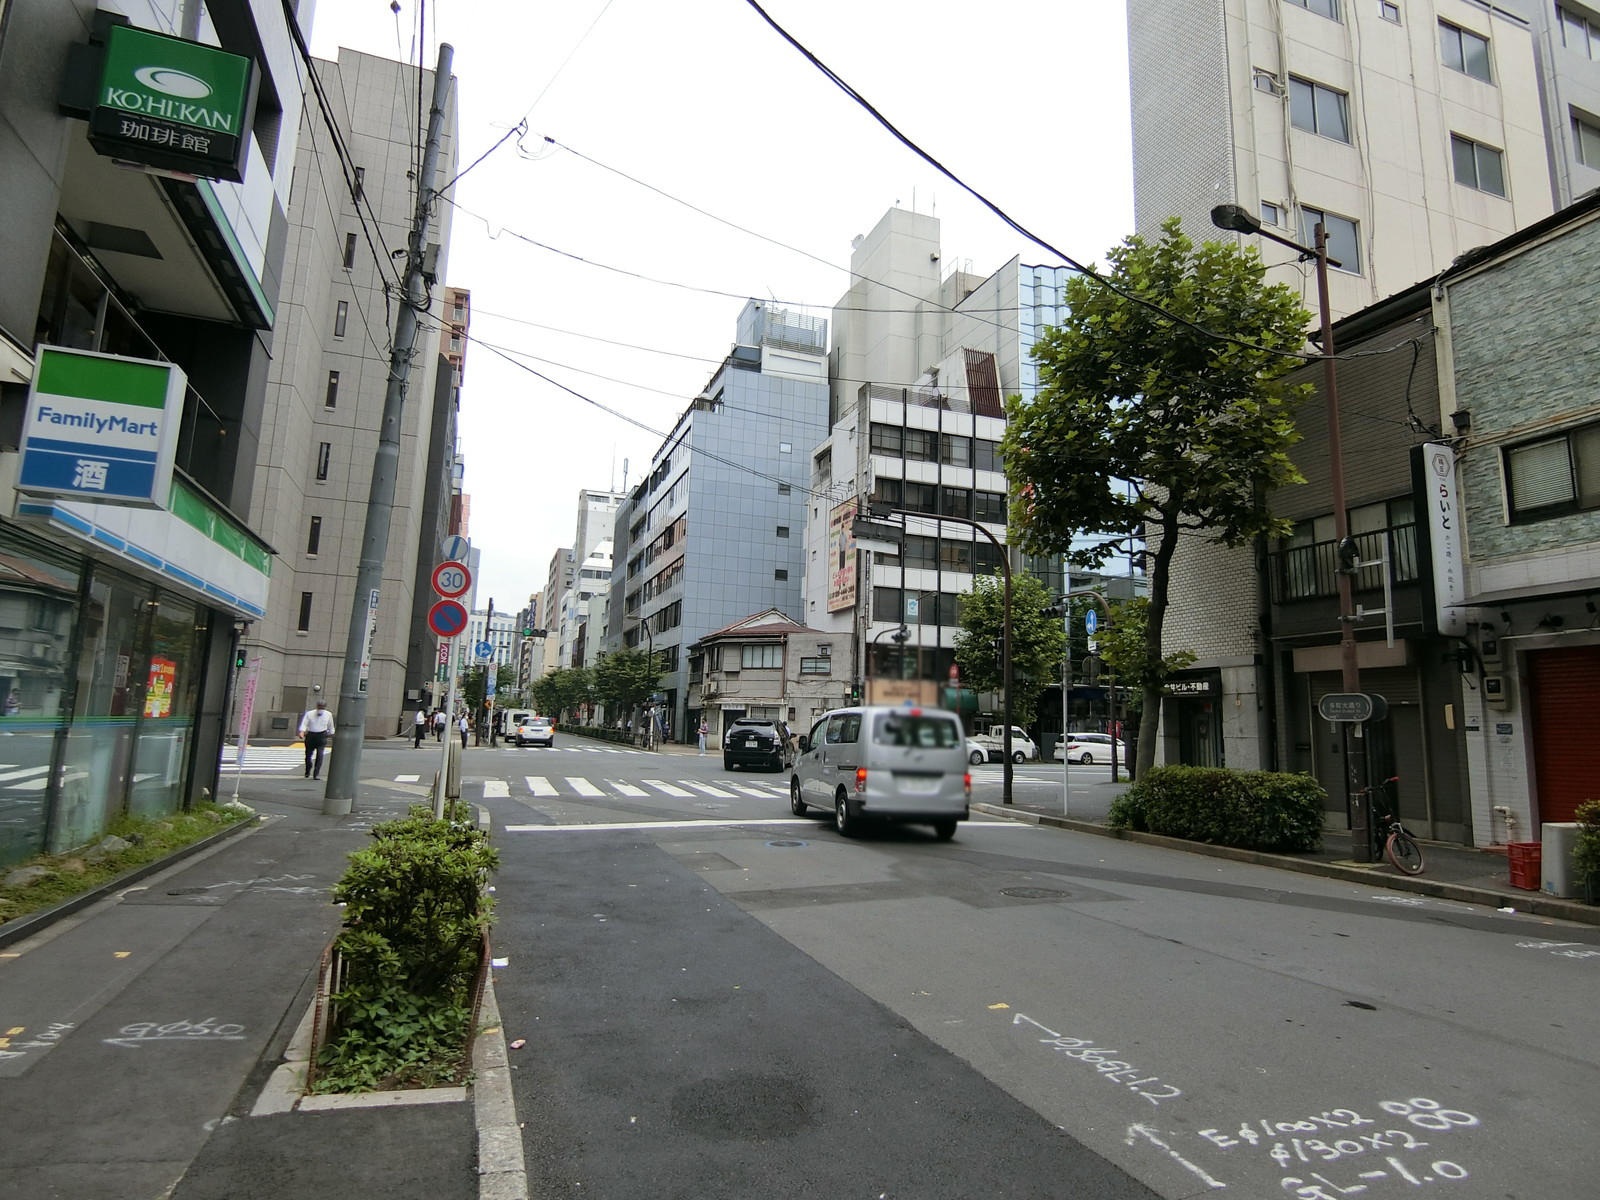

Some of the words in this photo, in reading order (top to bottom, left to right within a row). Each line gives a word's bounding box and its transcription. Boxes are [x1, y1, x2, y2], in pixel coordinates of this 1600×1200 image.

[120, 120, 211, 154] 珈琲館
[37, 406, 158, 436] FamilyMart
[72, 459, 109, 490] 酒
[1439, 484, 1450, 529] らいと
[441, 572, 463, 588] 30
